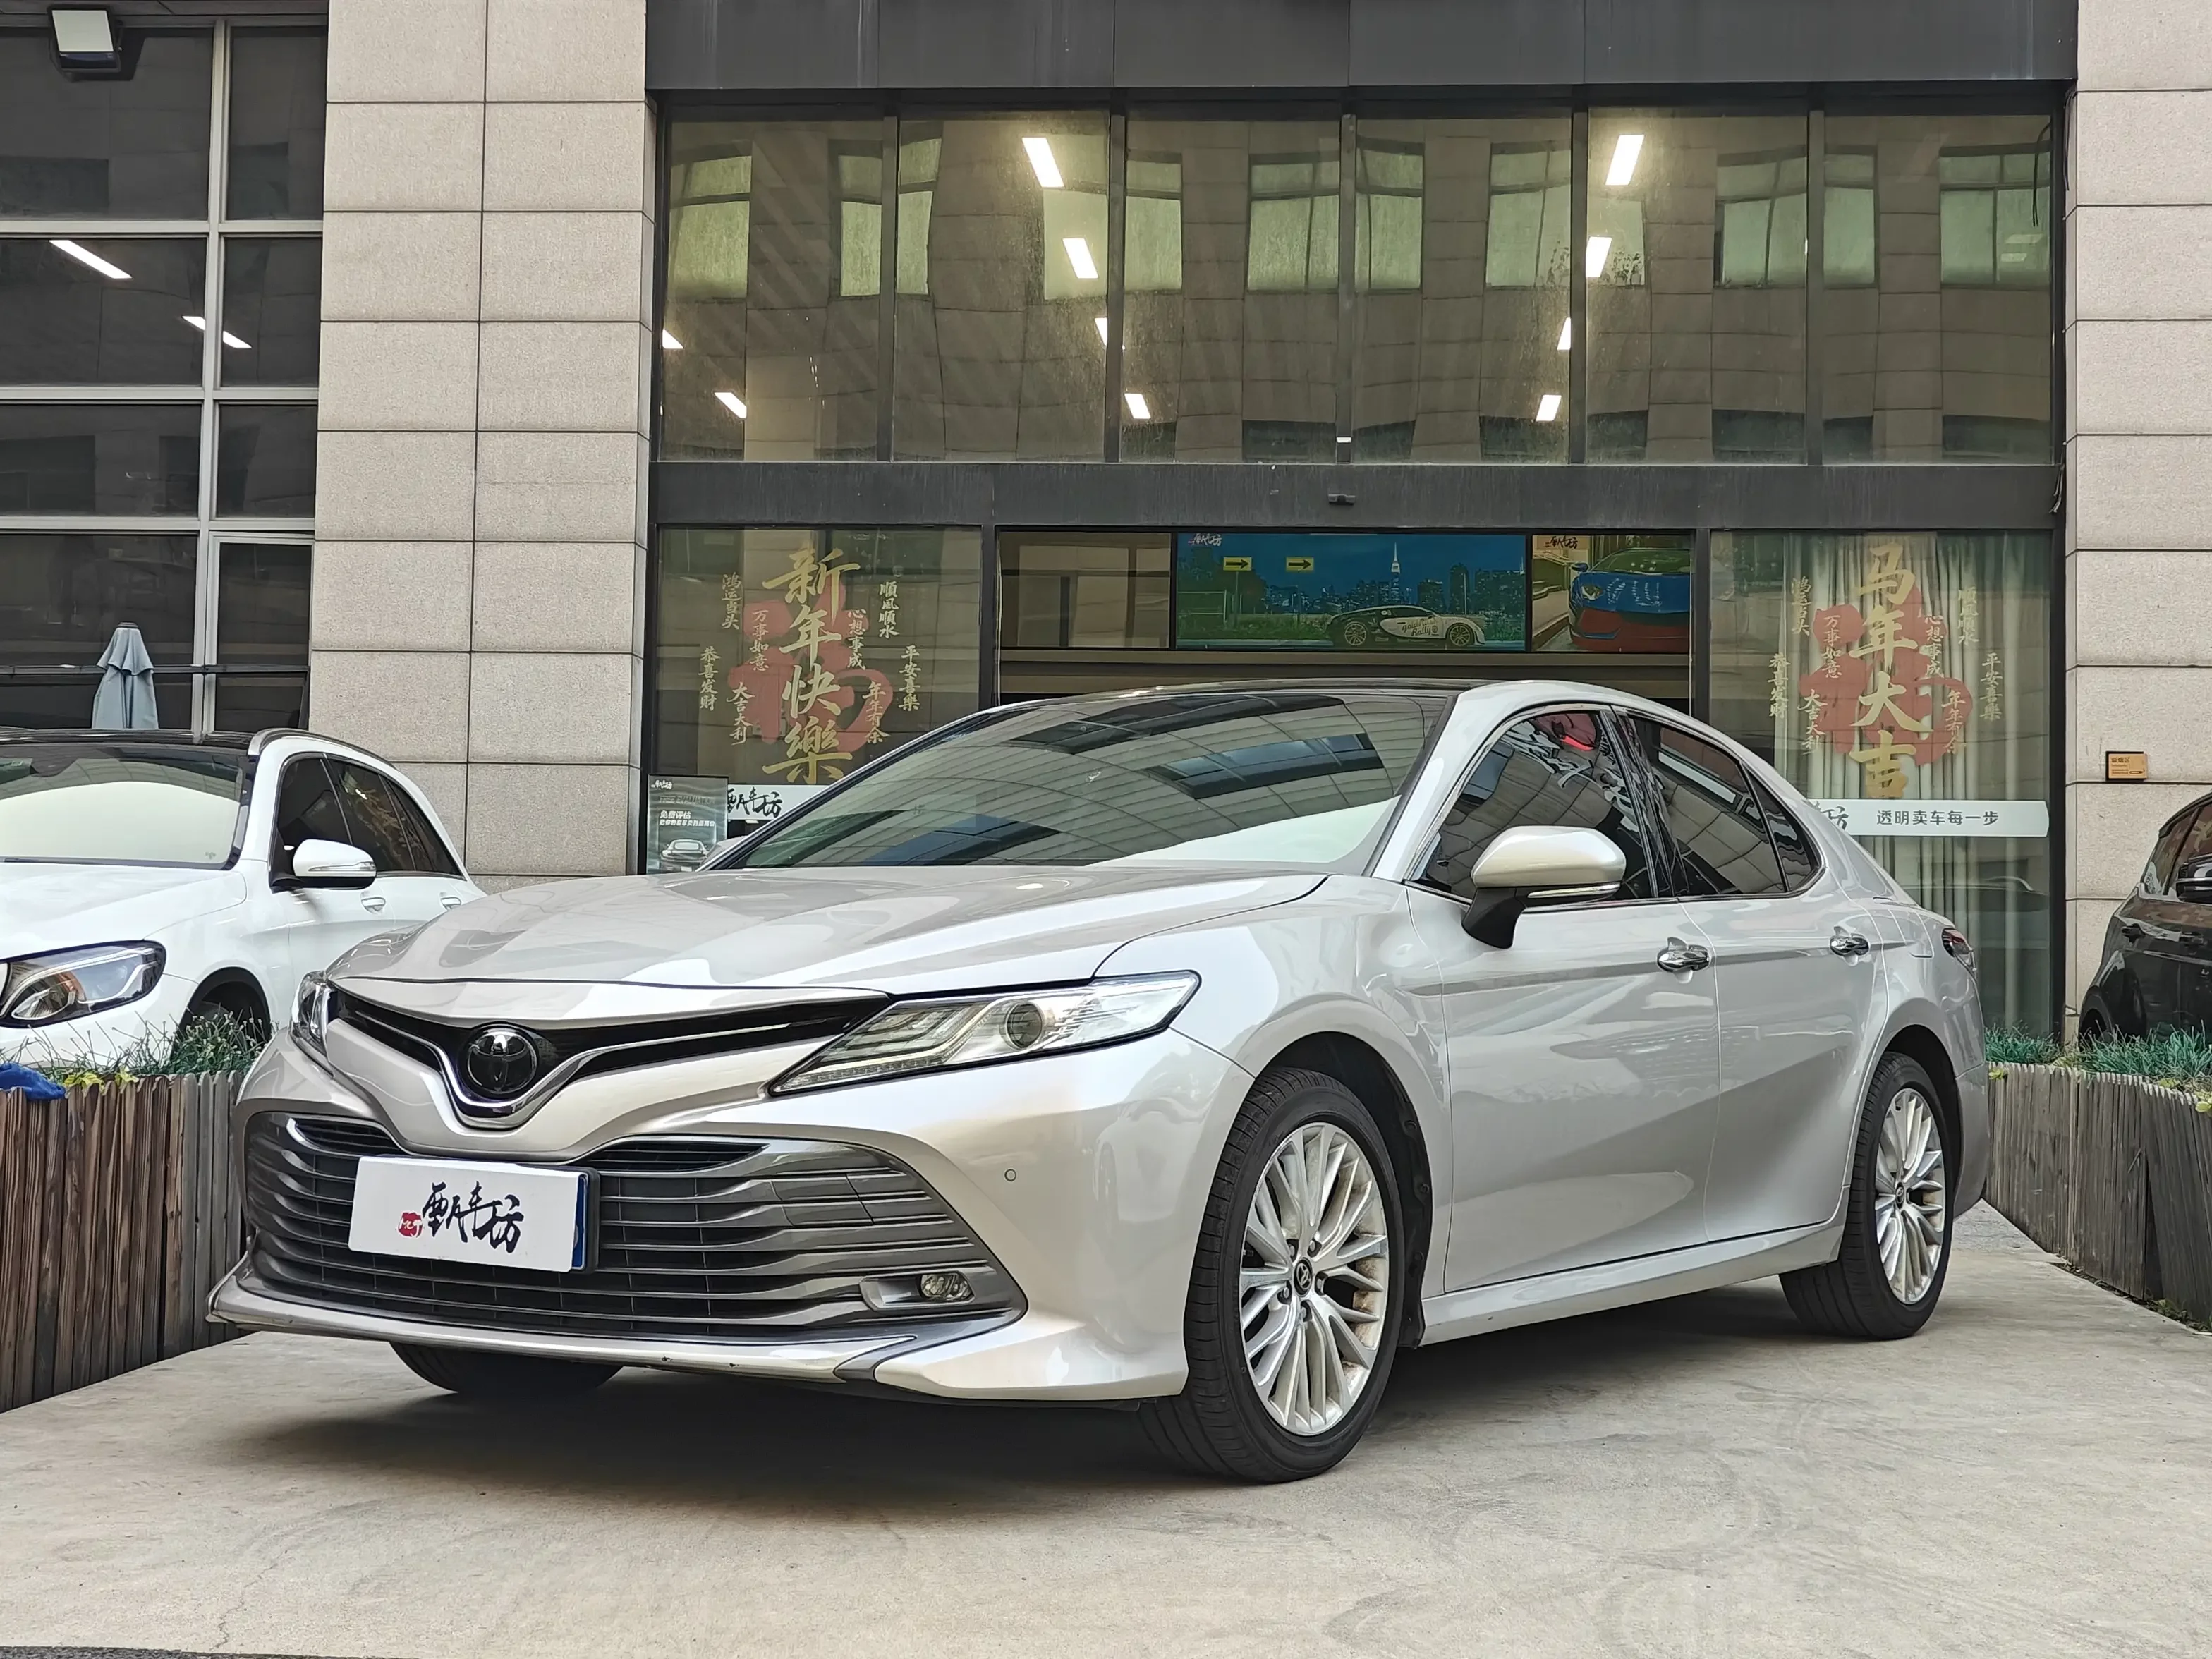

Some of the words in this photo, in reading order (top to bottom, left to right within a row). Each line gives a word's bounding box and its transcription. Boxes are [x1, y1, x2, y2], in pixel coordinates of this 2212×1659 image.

[722, 572, 743, 630] 鸿运当头
[1792, 576, 1812, 636] 鸿运当头
[750, 609, 770, 672] 万事如意
[762, 548, 861, 784] 新年快樂
[846, 609, 867, 670] 心想事成
[1822, 615, 1842, 679] 万事如意
[1849, 542, 1933, 798] 马年大吉
[1924, 615, 1944, 679] 心想事成
[698, 646, 721, 711] 恭喜发财
[1768, 652, 1790, 718] 恭喜发财
[727, 681, 755, 746] 大吉大利
[862, 681, 891, 744] 年年有余
[1797, 689, 1828, 755] 大吉大利
[1941, 689, 1968, 754] 年年有余
[660, 810, 692, 820] 免费评估
[1876, 810, 1999, 826] 透明卖车每一步
